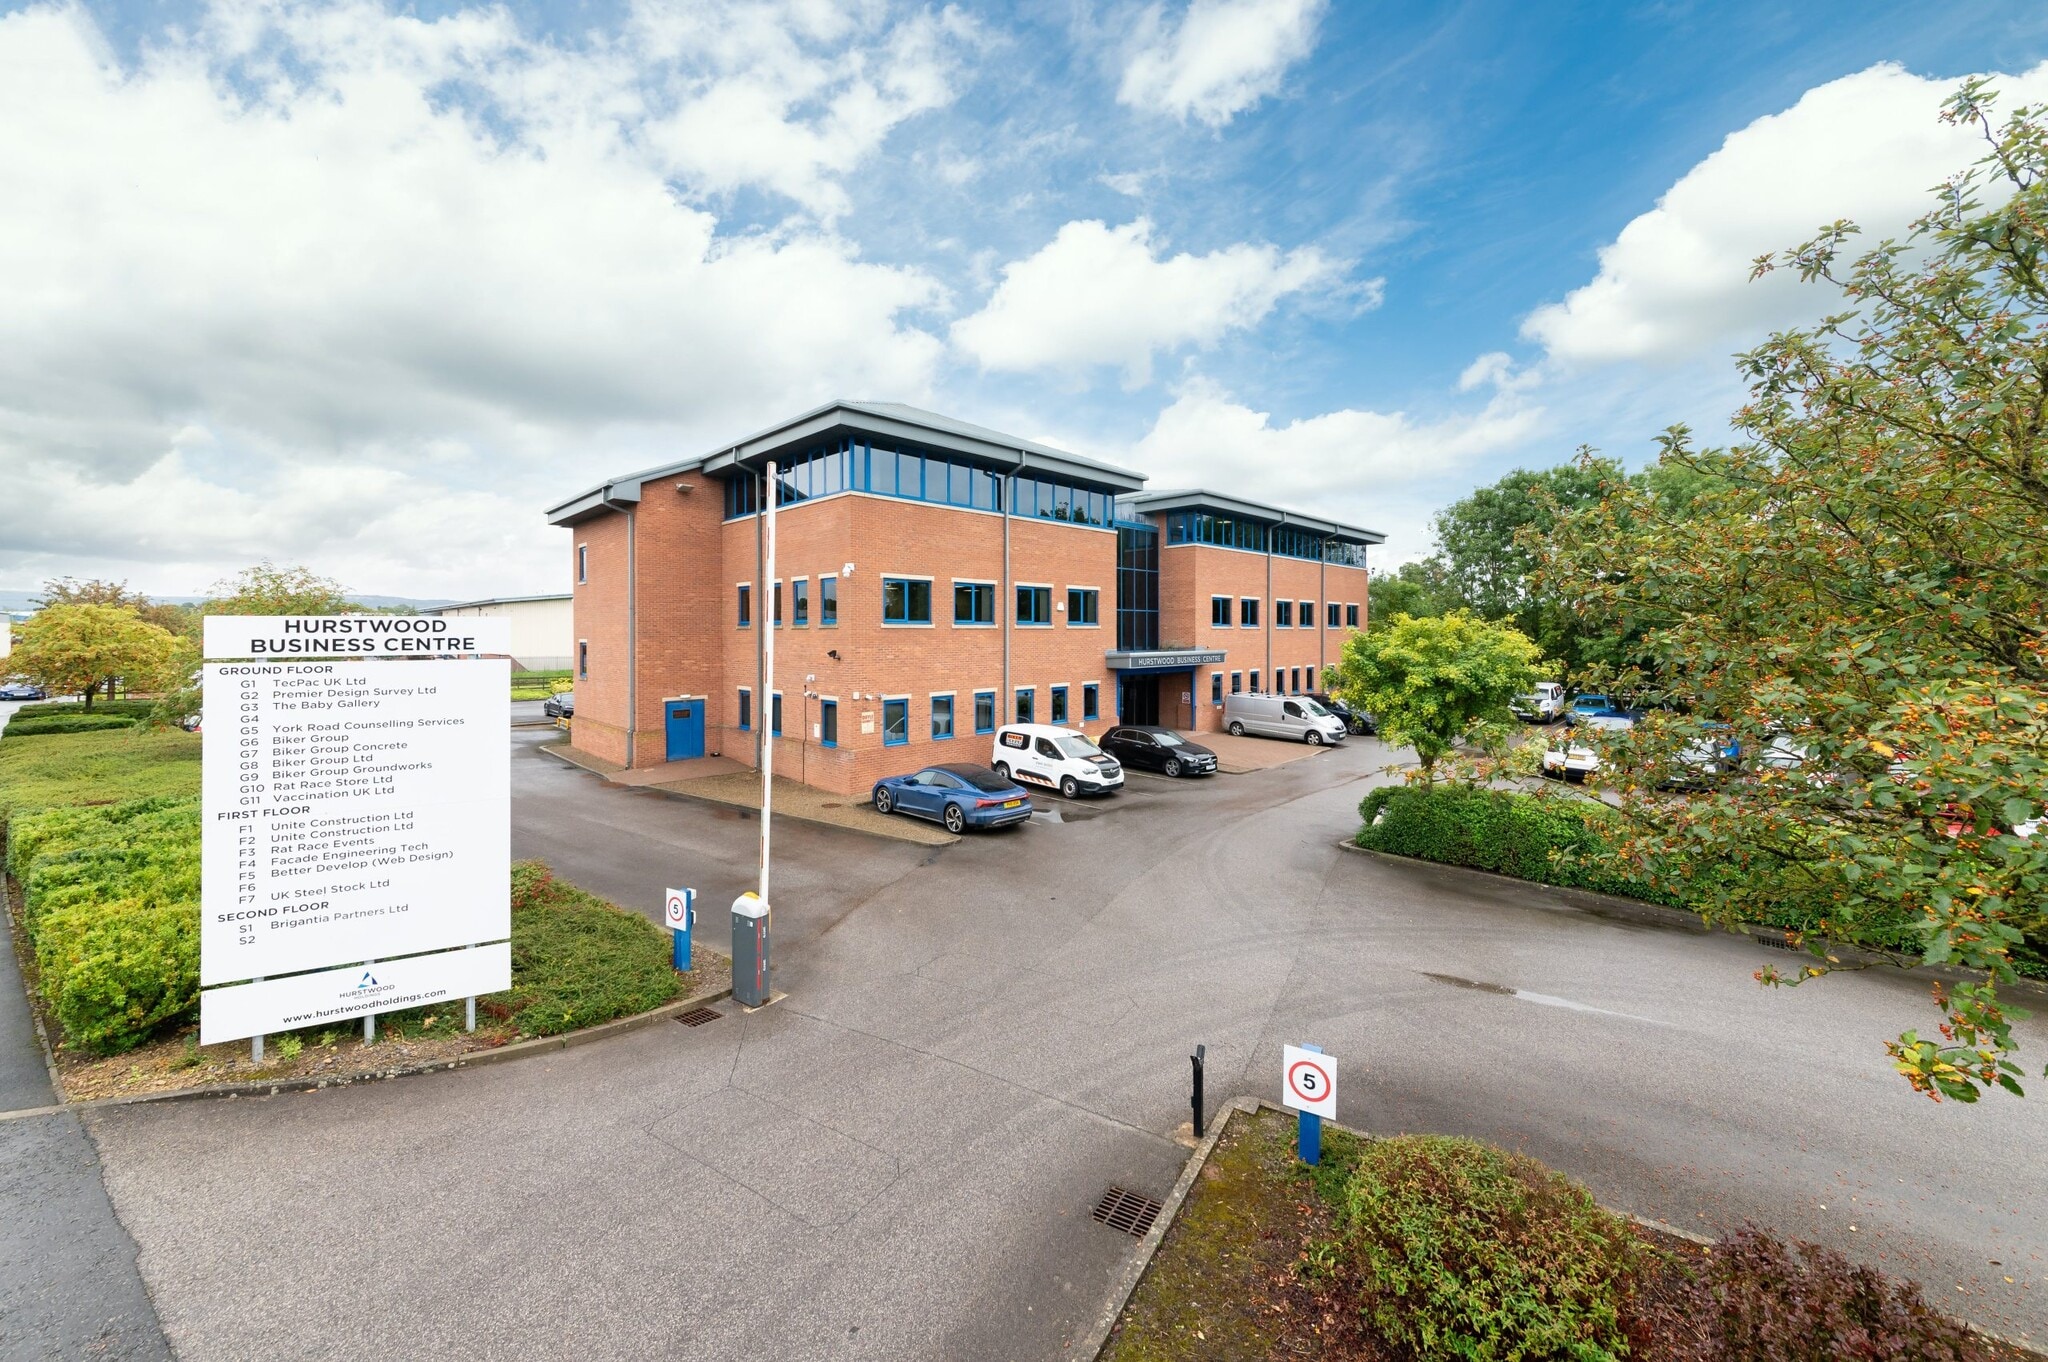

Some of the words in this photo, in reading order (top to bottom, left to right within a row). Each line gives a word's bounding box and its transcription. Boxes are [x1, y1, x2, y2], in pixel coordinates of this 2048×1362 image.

[285, 620, 446, 633] HURSTWOOD
[251, 638, 375, 653] BUSINESS
[384, 637, 475, 651] CENTRE
[1138, 657, 1175, 666] HURSTWOOD
[1177, 656, 1201, 664] BUSINESS
[219, 667, 282, 675] GROUND
[287, 666, 332, 674] FLOOR
[241, 680, 255, 688] G1
[273, 679, 319, 687] TecPac
[347, 677, 366, 685] Ltd
[241, 692, 258, 700] G2
[328, 690, 369, 698] Design
[374, 688, 413, 696] Survey
[241, 703, 258, 711] G3
[273, 702, 296, 710] The
[302, 701, 333, 709] Baby
[338, 700, 380, 708] Gallery
[241, 715, 259, 723] G4
[240, 727, 258, 735] G5
[273, 724, 302, 733] York
[308, 723, 339, 731] Road
[344, 720, 413, 730] Counselling
[240, 738, 258, 746] G6
[273, 736, 306, 744] Biker
[240, 750, 258, 758] G7
[273, 748, 305, 756] Biker
[310, 746, 349, 754] Group
[353, 742, 407, 751] Concrete
[240, 762, 258, 770] G8
[273, 759, 305, 767] Biker
[310, 757, 349, 765] Group
[354, 754, 373, 762] Ltd
[240, 773, 258, 782] G9
[273, 771, 305, 779] Biker
[310, 768, 348, 776] Group
[353, 762, 432, 773] Groundworks
[240, 784, 264, 793] G10
[274, 782, 295, 790] Rat
[301, 781, 331, 789] Race
[373, 775, 392, 784] Ltd
[240, 796, 260, 805] G11
[273, 791, 348, 802] Vaccination
[353, 788, 370, 796] UK
[375, 786, 394, 794] Ltd
[218, 810, 258, 820] FIRST
[263, 806, 310, 817] FLOOR
[240, 825, 252, 833] F1
[272, 822, 305, 831] Unite
[310, 813, 391, 828] Construction
[395, 811, 413, 820] Ltd
[240, 837, 255, 845] F2
[271, 833, 305, 842] Unite
[310, 824, 391, 839] Construction
[394, 822, 413, 830] Ltd
[240, 848, 255, 857] F3
[271, 845, 292, 854] Rat
[298, 843, 328, 851] Race
[334, 838, 374, 848] Events
[240, 860, 255, 869] F4
[272, 854, 318, 865] Facade
[323, 846, 396, 862] Engineering
[401, 843, 428, 851] Tech
[239, 872, 255, 880] F5
[272, 867, 311, 877] Better
[317, 861, 368, 872] Develop
[372, 856, 405, 867] (Web
[410, 851, 453, 862] Design)
[239, 883, 255, 892] F6
[239, 895, 255, 904] F7
[271, 891, 289, 900] UK
[295, 887, 326, 897] Steel
[331, 882, 365, 893] Stock
[370, 879, 389, 888] Ltd
[218, 908, 277, 922] SECOND
[283, 902, 329, 914] FLOOR
[673, 904, 679, 915] 5
[240, 924, 252, 933] S1
[271, 916, 329, 929] Brigantia
[334, 909, 384, 920] Partners
[390, 904, 408, 913] Ltd
[240, 936, 255, 945] S2
[339, 984, 396, 998] HURSTWOOD
[283, 989, 447, 1023] www.hurstwoodholdings.com
[1303, 1072, 1316, 1091] 5
